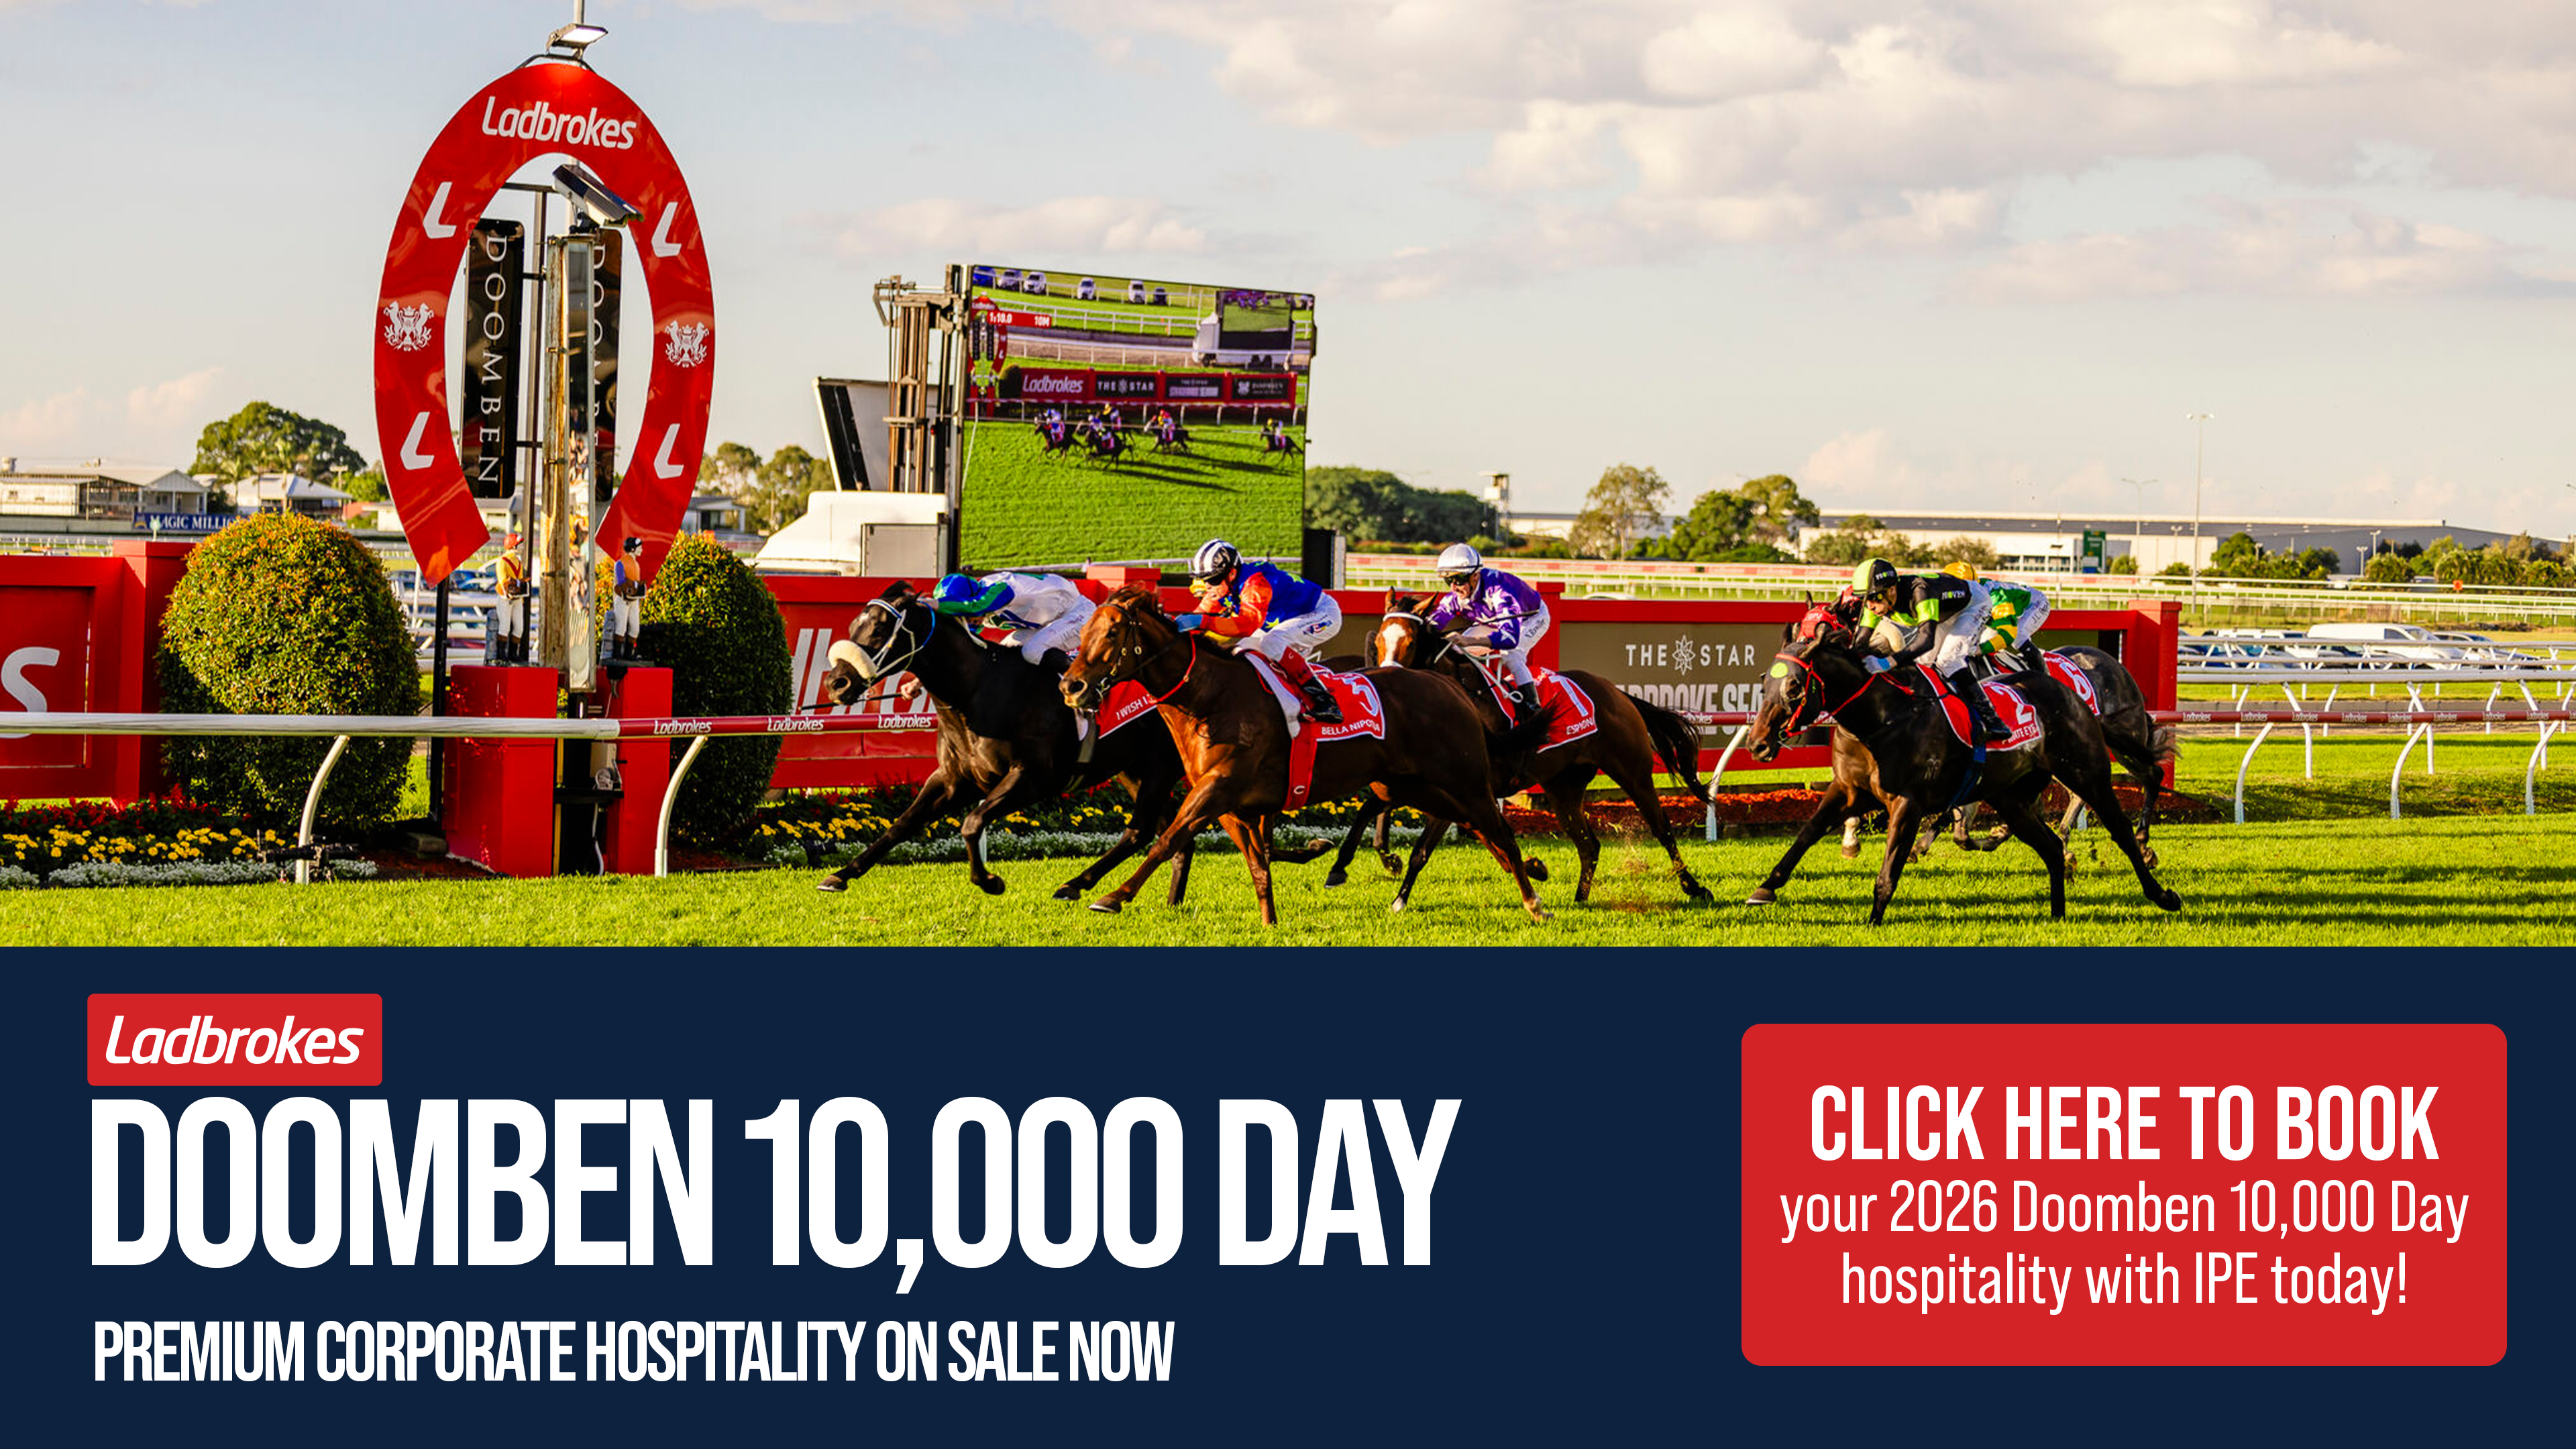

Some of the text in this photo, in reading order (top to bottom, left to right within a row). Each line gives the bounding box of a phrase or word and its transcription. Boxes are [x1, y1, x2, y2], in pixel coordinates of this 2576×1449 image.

[482, 96, 637, 150] Ladbrokes
[478, 235, 508, 483] DOOMBEN
[1023, 375, 1083, 393] Ladbrokes
[1097, 381, 1154, 391] THE STAR
[1625, 644, 1755, 666] THE STAR
[1990, 686, 2033, 725] 2
[653, 719, 712, 735] Ladbrokes
[767, 717, 824, 733] Ladbrokes
[877, 714, 933, 729] Ladbrokes
[1321, 726, 1349, 735] BELLA
